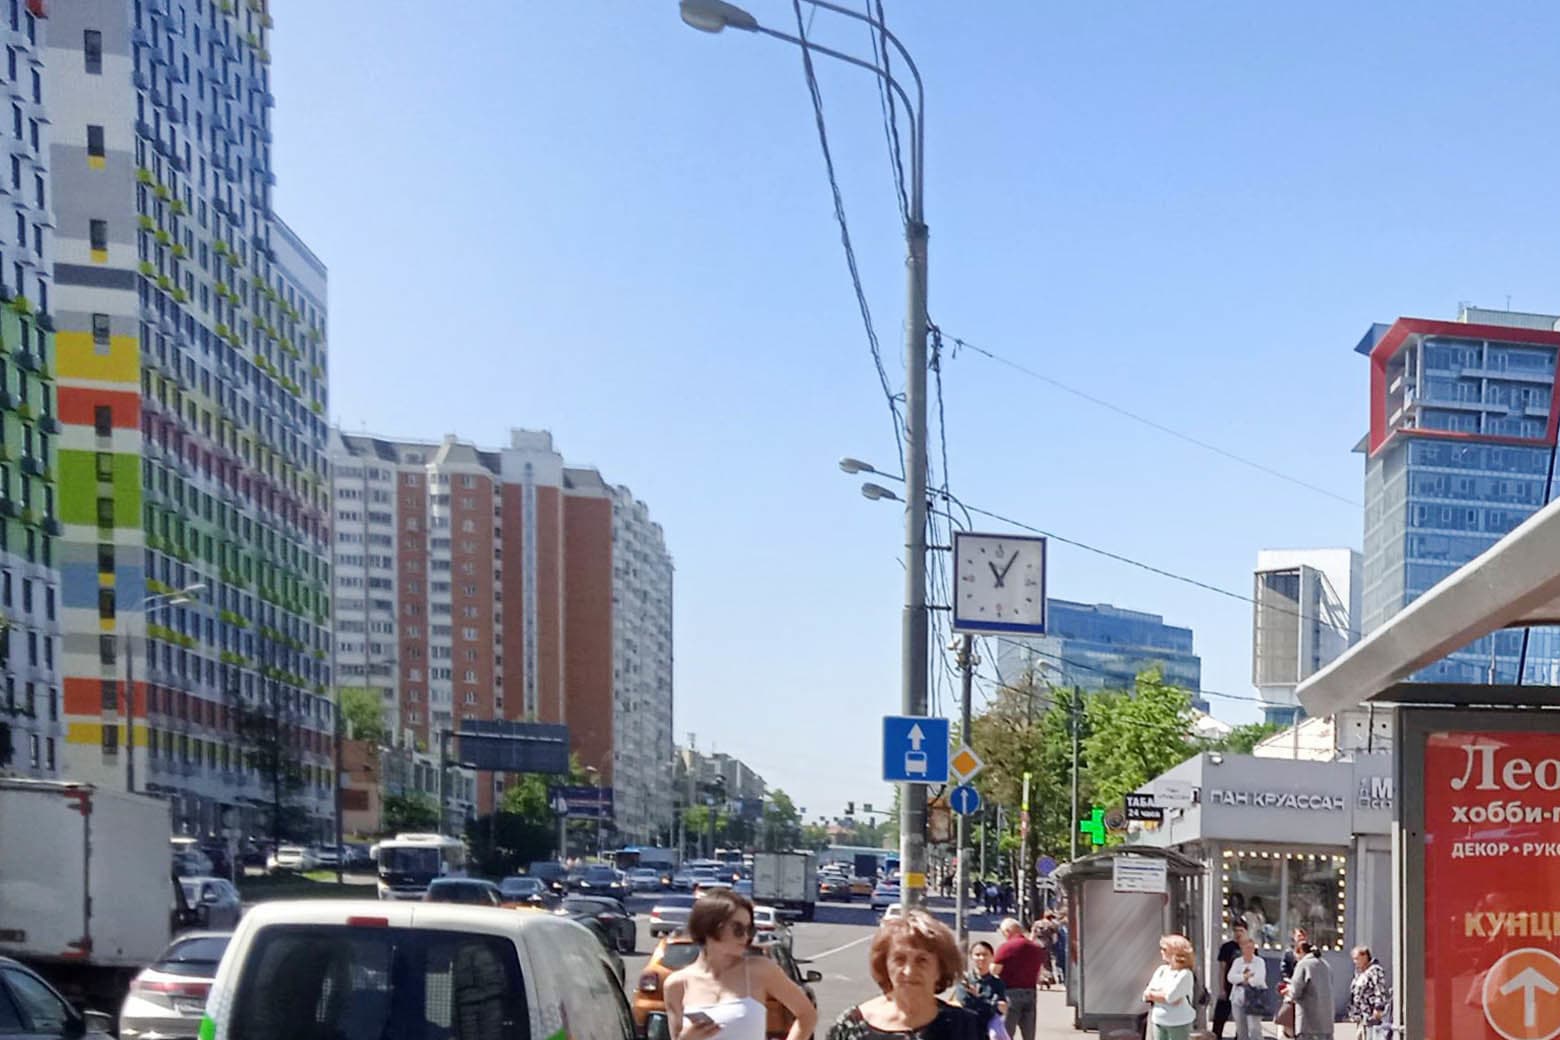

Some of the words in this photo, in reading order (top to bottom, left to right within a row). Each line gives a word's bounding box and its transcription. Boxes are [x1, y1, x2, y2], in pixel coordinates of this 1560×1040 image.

[1127, 796, 1154, 807] ТАБА
[1211, 789, 1248, 805] ПАН
[1254, 791, 1345, 811] КРУАССАН
[1452, 843, 1509, 859] ДЕКОР
